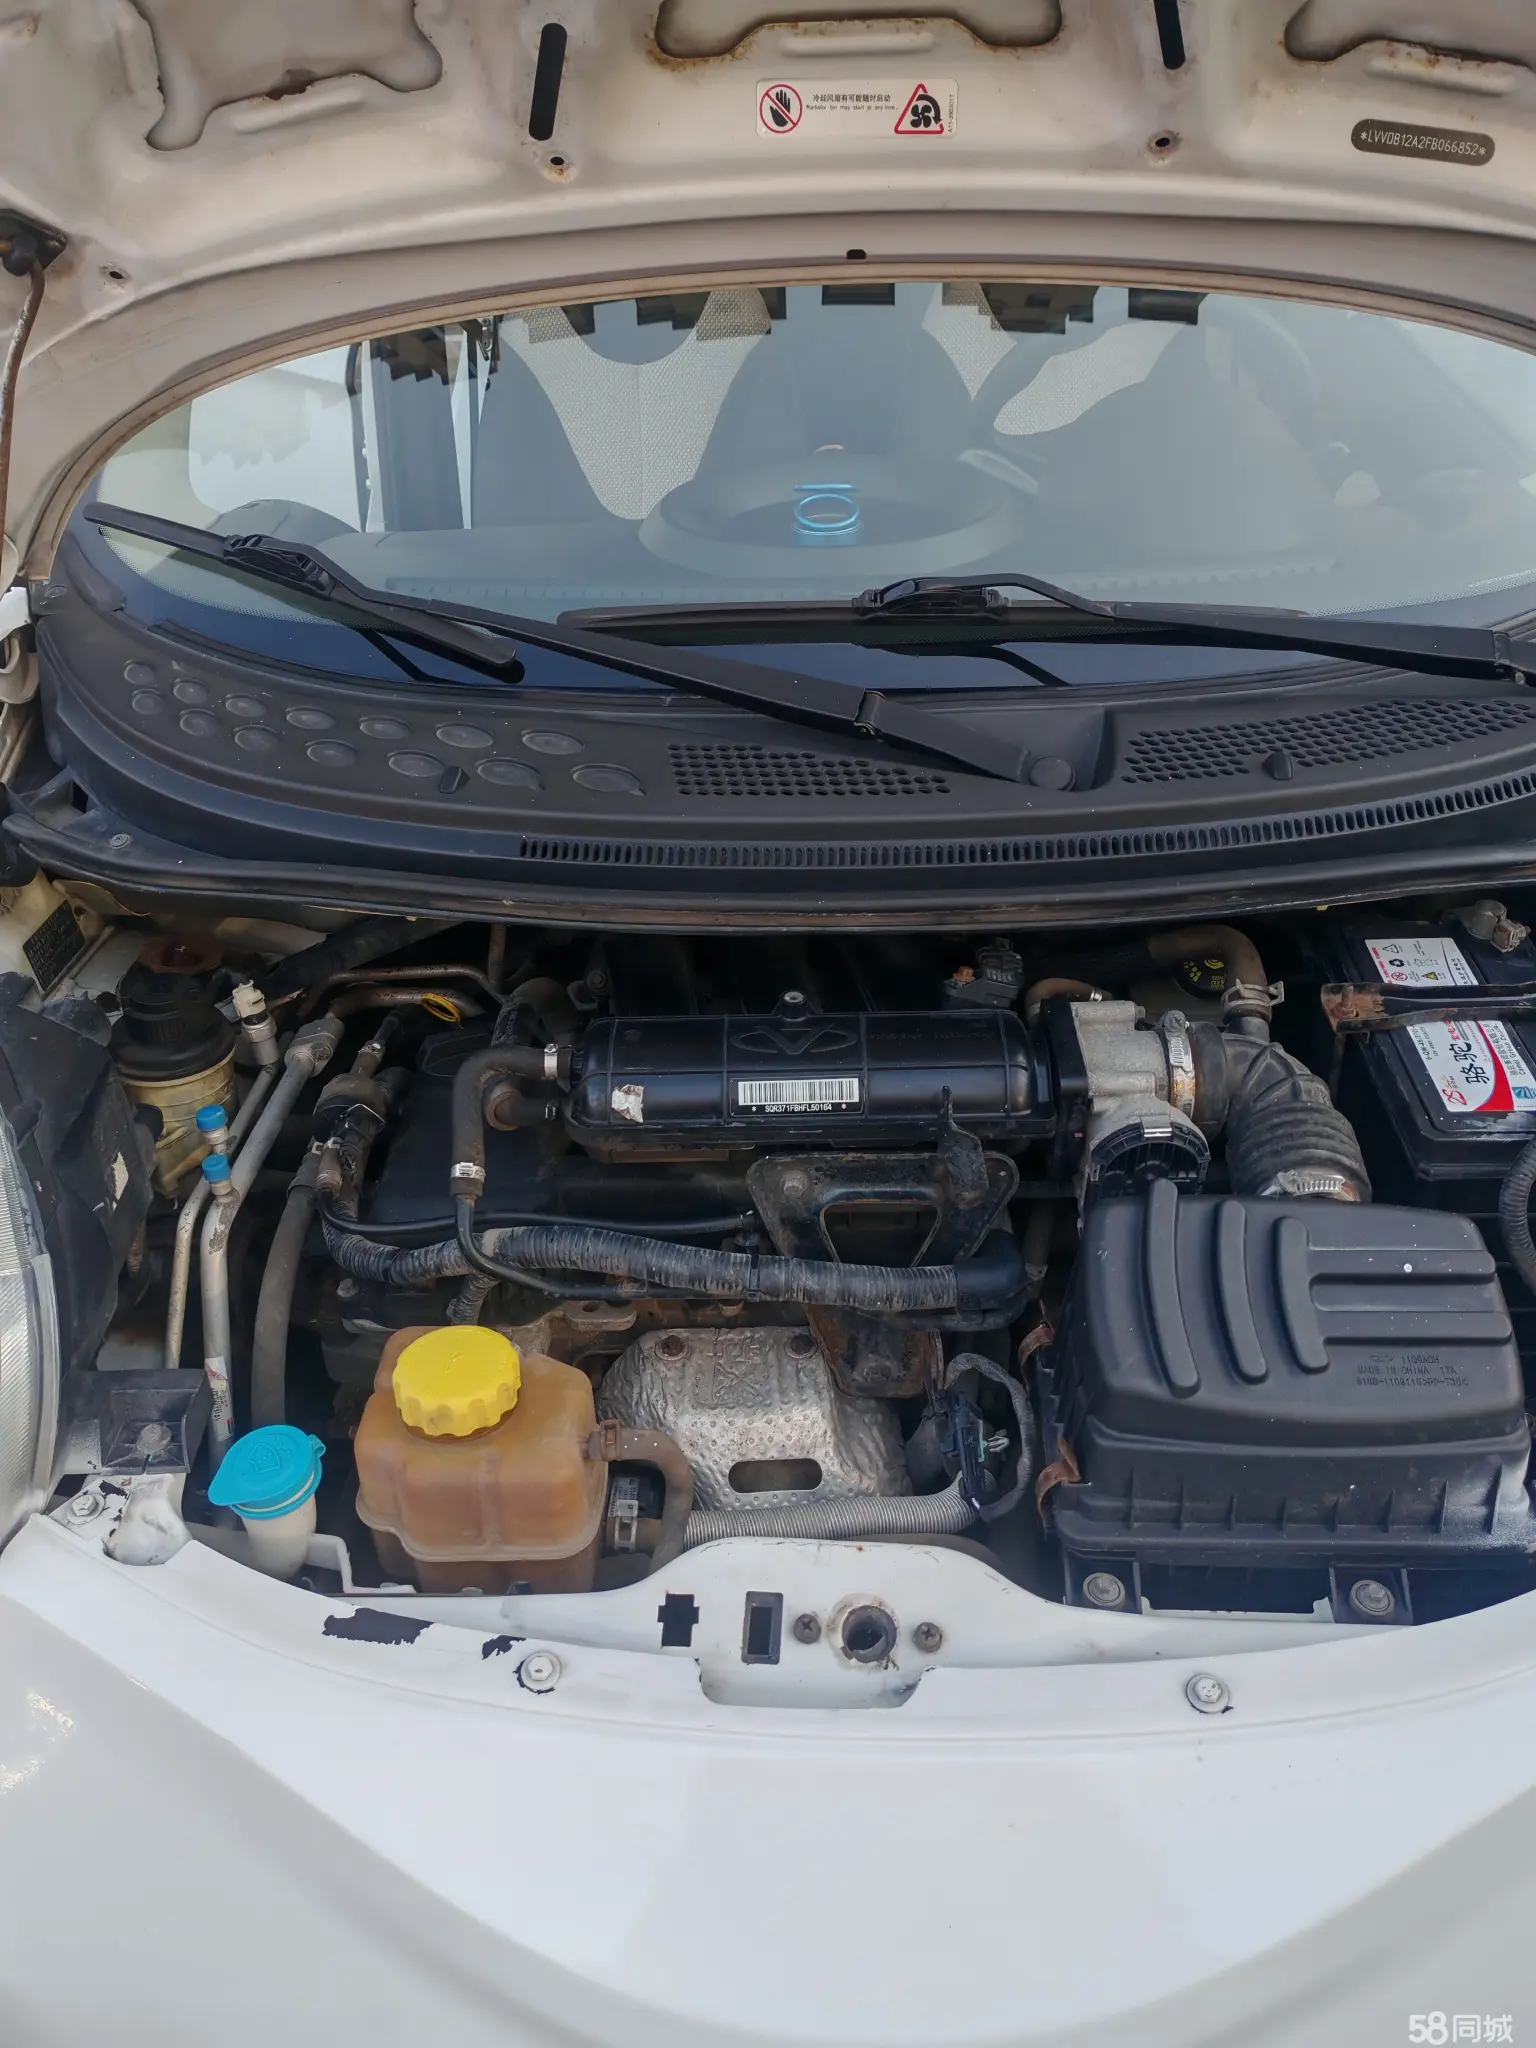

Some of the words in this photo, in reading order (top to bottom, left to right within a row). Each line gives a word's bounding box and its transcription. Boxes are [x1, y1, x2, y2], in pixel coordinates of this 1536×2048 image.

[812, 94, 891, 102] 冷却风扇有可能随时启动
[1449, 1041, 1490, 1085] 骆驼
[1357, 1365, 1381, 1375] MADE
[1386, 1365, 1396, 1375] IN
[1401, 1365, 1430, 1375] CHINA
